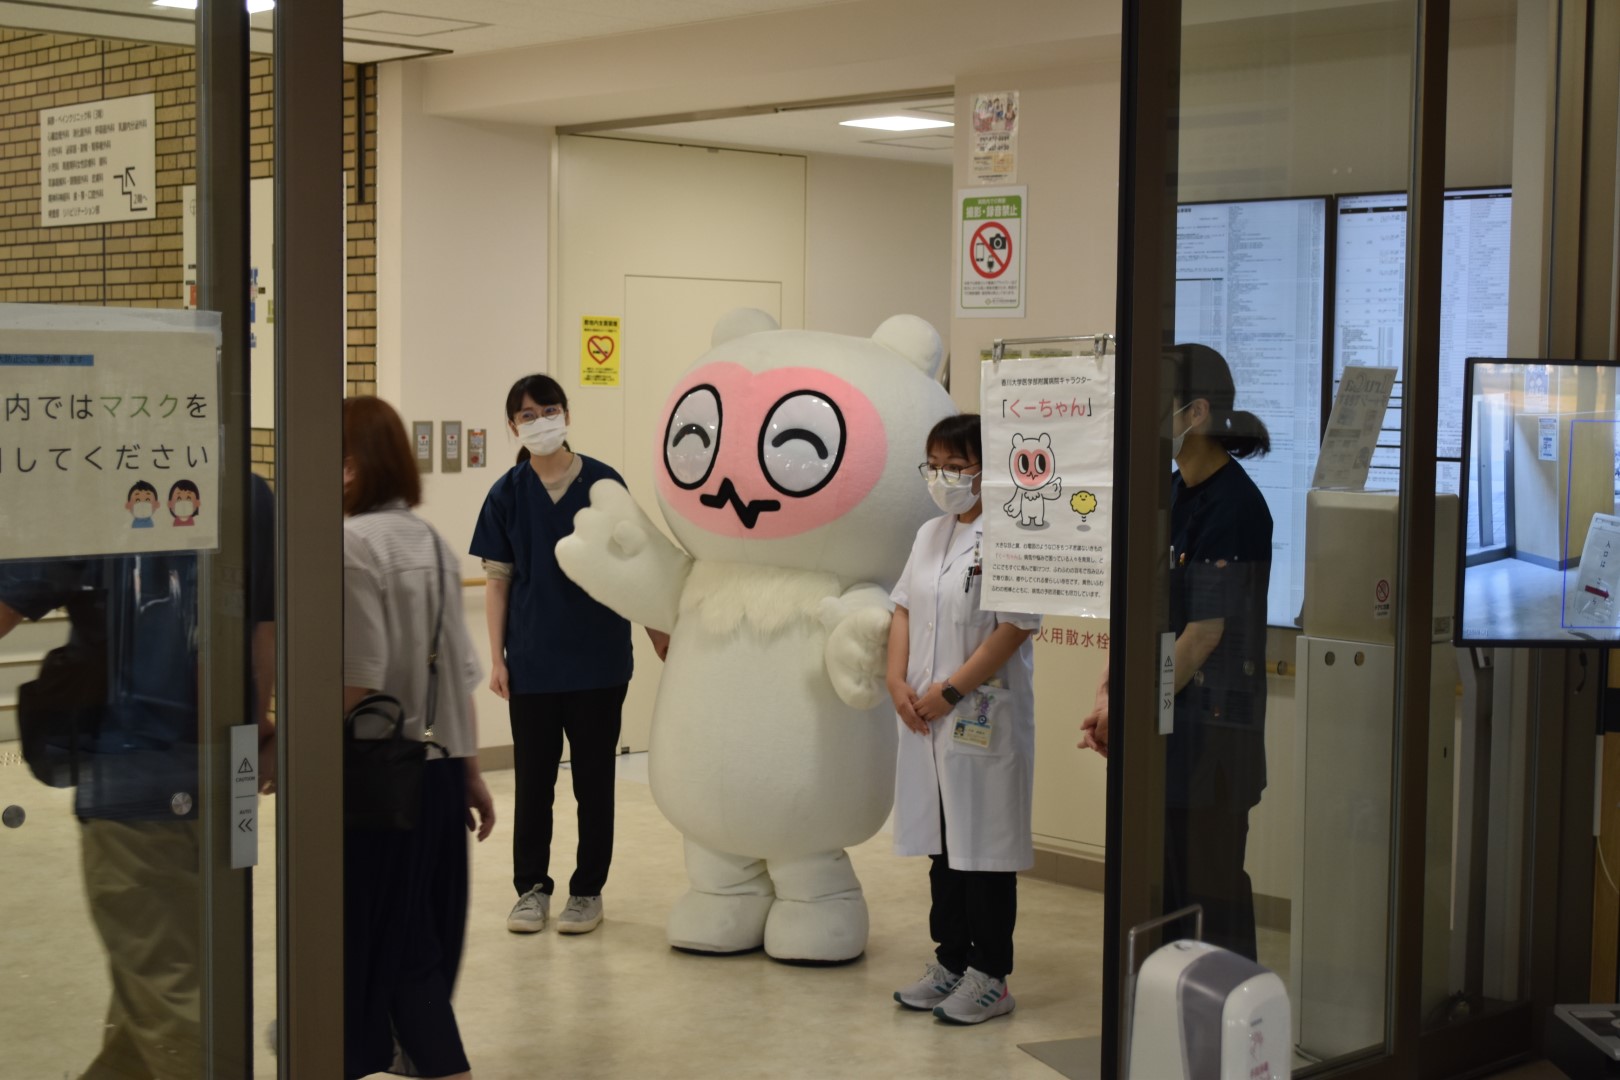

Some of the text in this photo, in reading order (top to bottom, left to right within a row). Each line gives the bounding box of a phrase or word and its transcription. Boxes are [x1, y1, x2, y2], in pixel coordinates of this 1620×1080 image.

[5, 393, 208, 422] 内ではマスクを
[1002, 397, 1092, 419] 「くーちゃん」
[0, 443, 209, 474] してください
[1035, 625, 1110, 650] 火用散水栓
